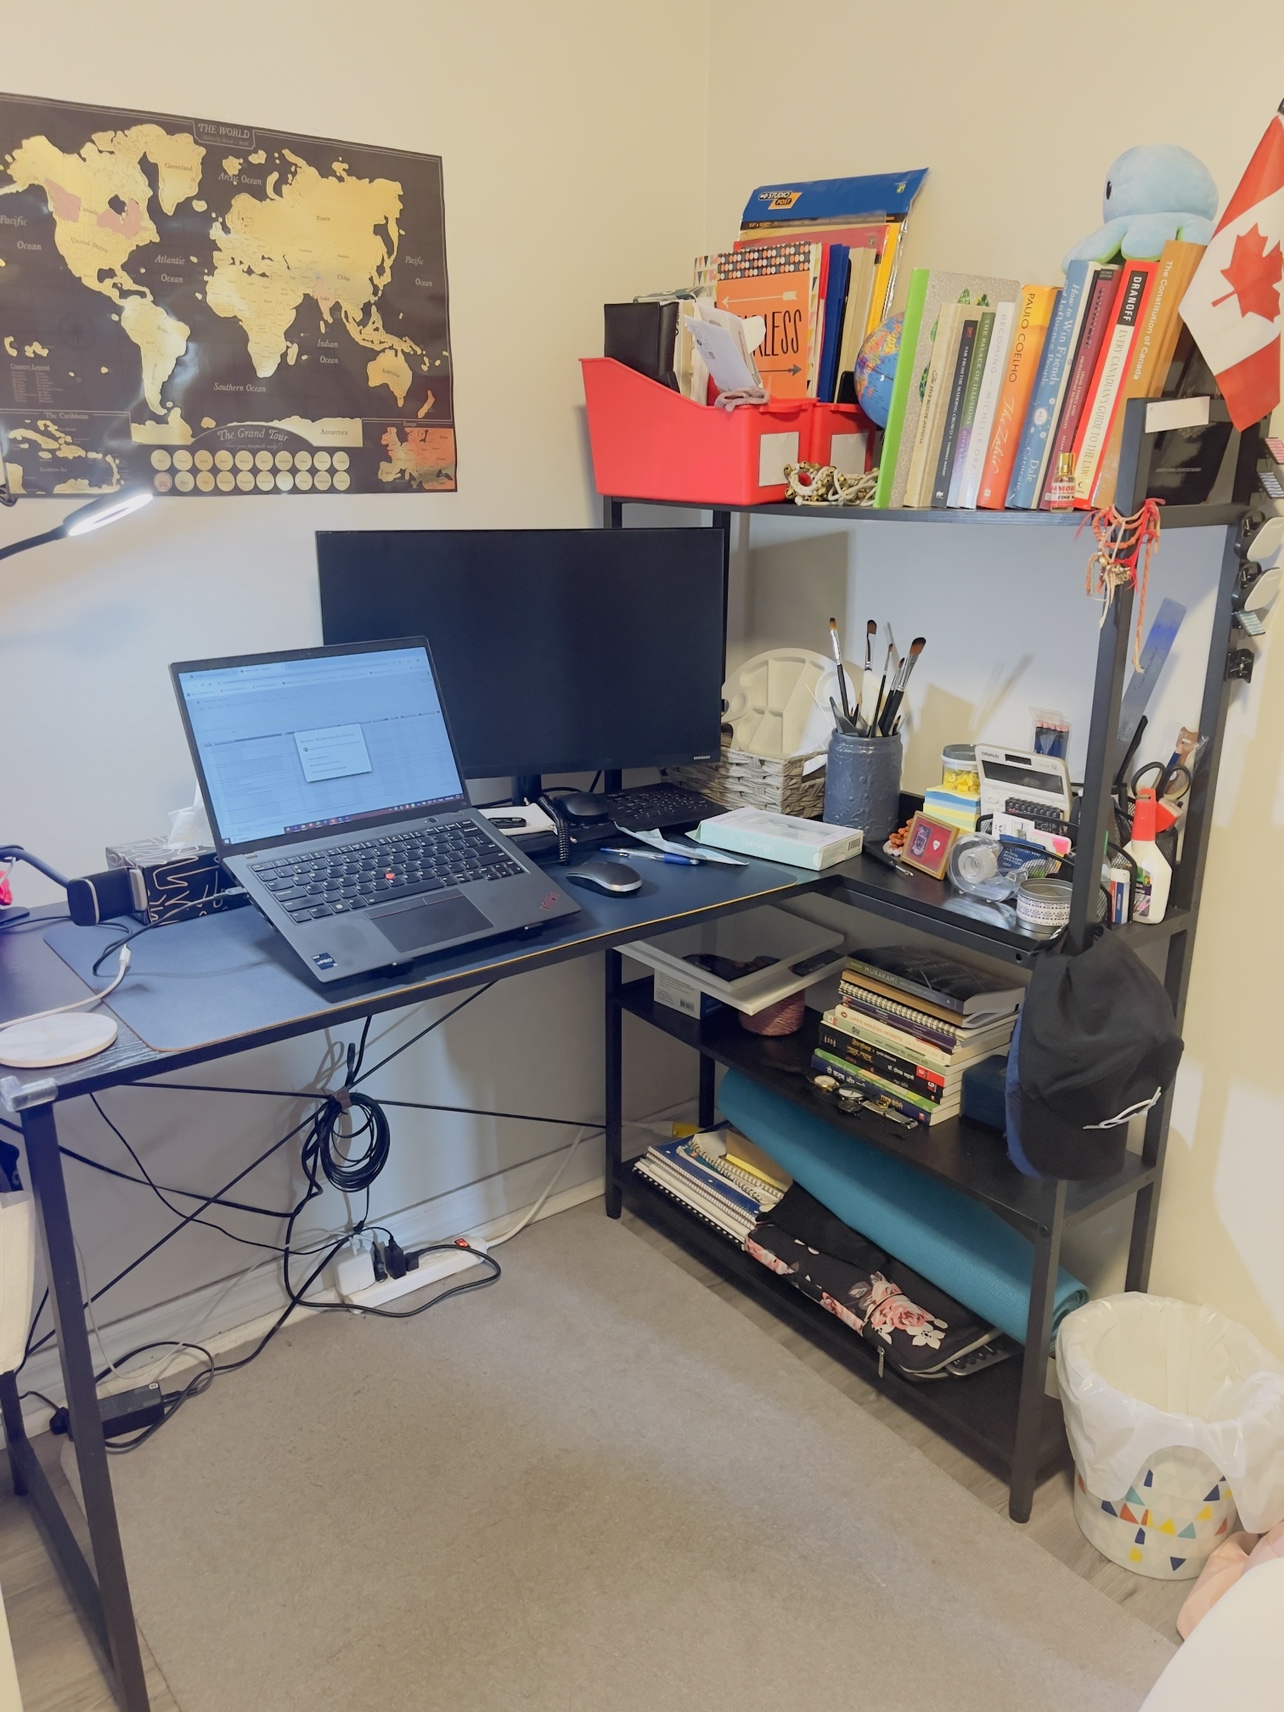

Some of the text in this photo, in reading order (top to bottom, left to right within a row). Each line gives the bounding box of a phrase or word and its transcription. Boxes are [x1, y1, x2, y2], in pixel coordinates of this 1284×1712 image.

[198, 124, 250, 138] THE WORLD
[164, 162, 193, 172] Greenland
[218, 172, 262, 186] Arctic Ocean
[0, 214, 28, 227] Pacific
[16, 240, 42, 250] Ocean
[154, 254, 186, 265] Atlantic
[405, 256, 424, 266] Pacific
[161, 273, 184, 284] Ocean
[415, 278, 432, 287] Ocean
[1122, 274, 1142, 322] DRANOFF
[1049, 299, 1066, 347] Influence
[1132, 259, 1173, 381] The Constitution of Canada
[318, 339, 338, 348] Indian
[988, 313, 1008, 374] BECOMING
[1006, 292, 1036, 383] PAULO COELHO
[1048, 283, 1080, 386] How to Win Friends
[1113, 329, 1127, 354] EVERY
[320, 356, 338, 364] Ocean
[964, 319, 990, 426] THE PALACE OF ILLUSIONS
[1039, 352, 1054, 388] People
[213, 382, 266, 393] Southern Ocean
[1099, 355, 1120, 404] CANADIAN'S
[952, 385, 962, 412] MADDING
[1072, 385, 1081, 403] ETHICS
[974, 390, 992, 444] MICHELLE
[997, 395, 1016, 426] The
[1092, 404, 1106, 430] GUIDE
[320, 428, 348, 436] Antarctica
[948, 412, 957, 435] CROWD
[217, 428, 290, 442] The Grand Tour
[1089, 431, 1099, 442] TO
[1084, 442, 1096, 459] THE
[1025, 458, 1039, 483] Dale
[1080, 459, 1092, 477] LAW
[862, 965, 899, 985] MURAKAMI
